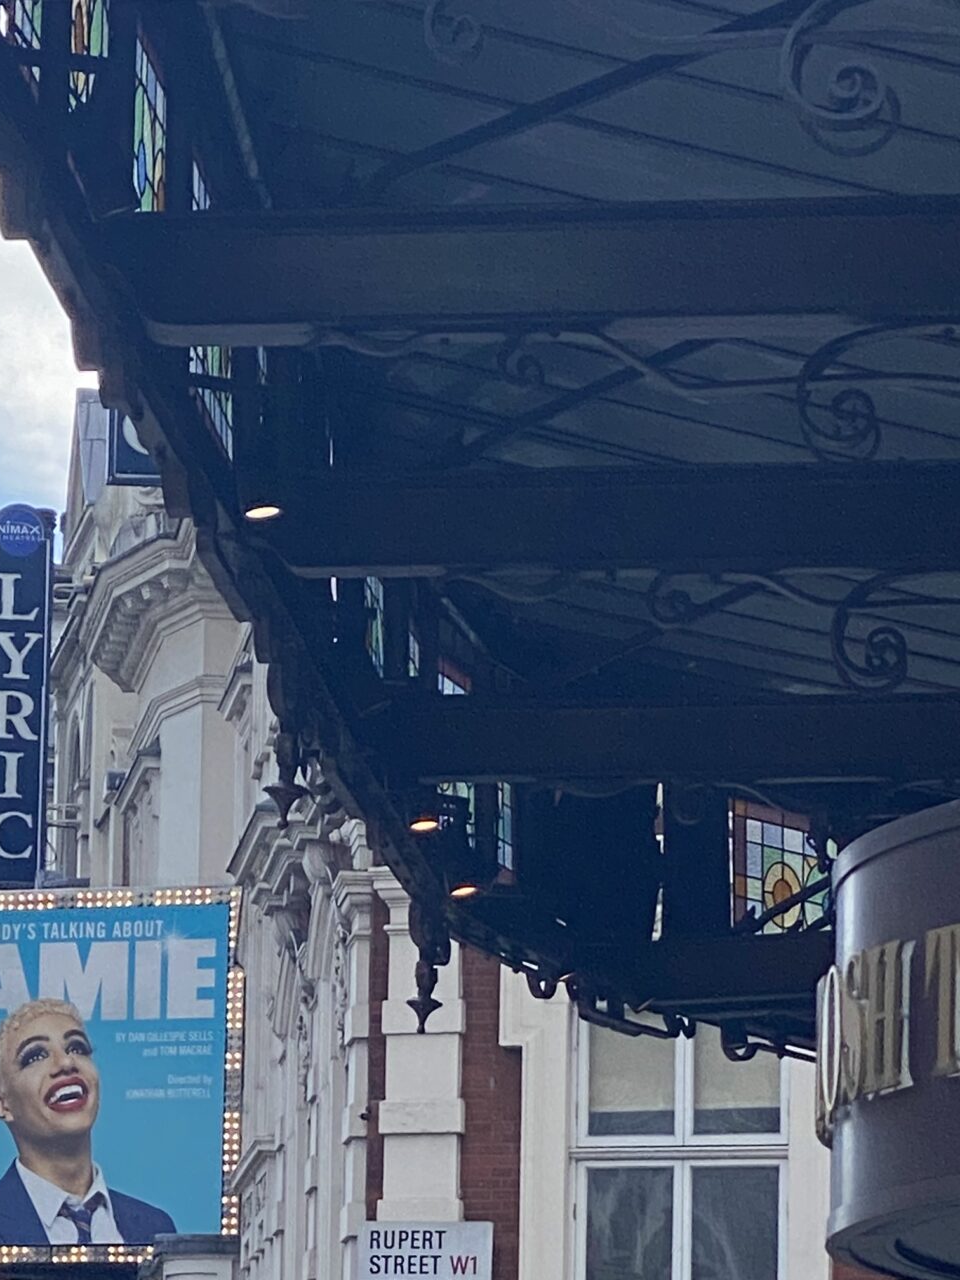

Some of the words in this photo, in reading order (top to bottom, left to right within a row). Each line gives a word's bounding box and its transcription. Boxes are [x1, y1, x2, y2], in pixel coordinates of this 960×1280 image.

[43, 922, 105, 940] TALKING
[112, 920, 164, 938] ABOUT
[369, 1230, 447, 1249] RUPERT
[369, 1255, 442, 1275] STREET
[449, 1255, 478, 1275] W1
